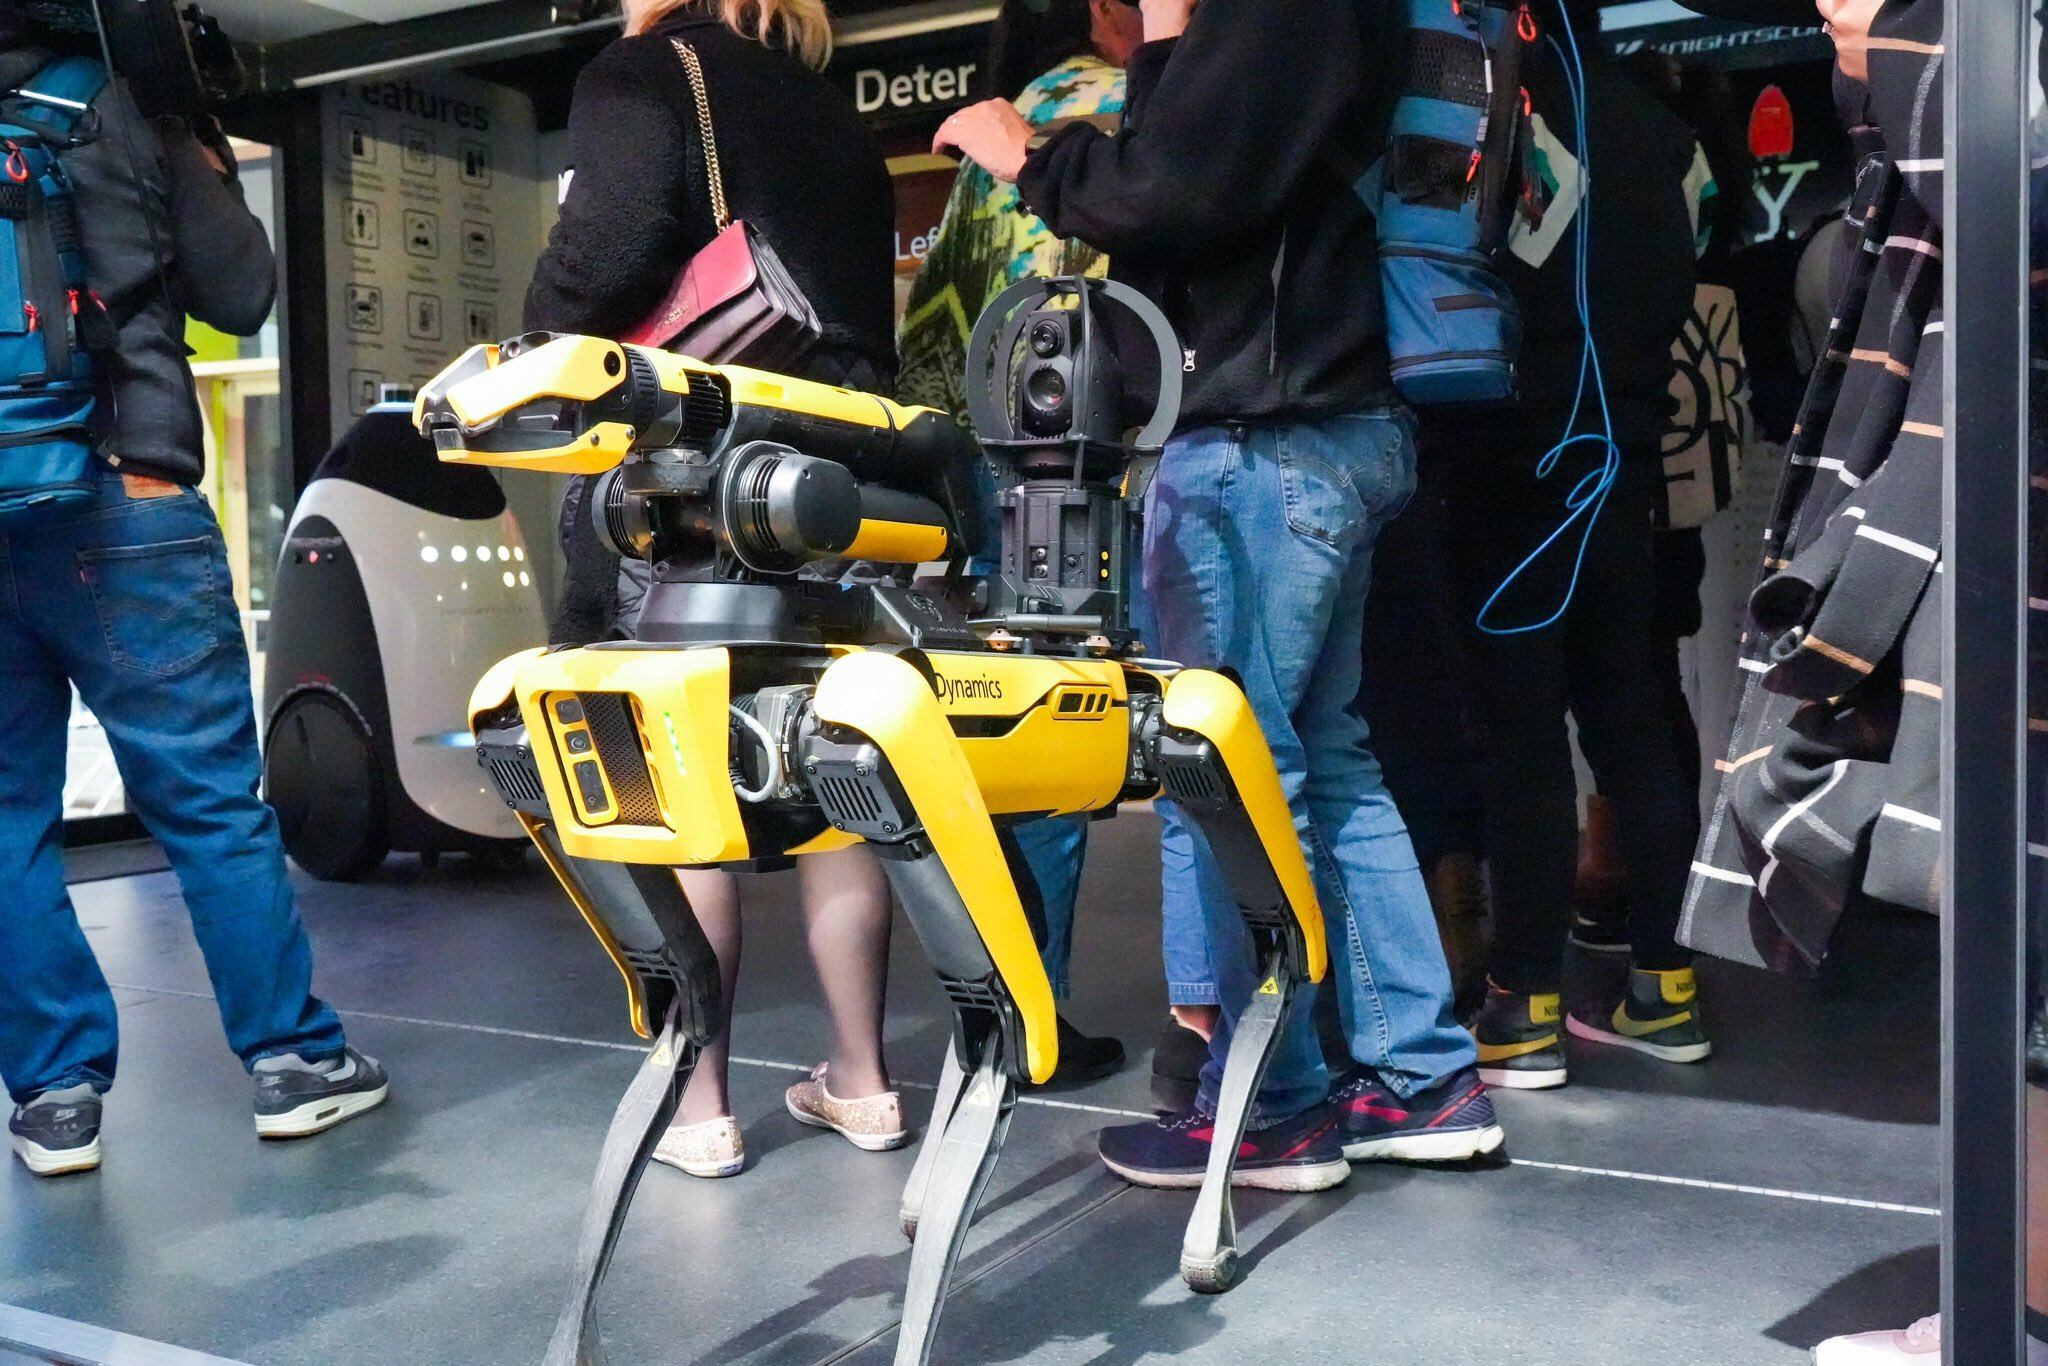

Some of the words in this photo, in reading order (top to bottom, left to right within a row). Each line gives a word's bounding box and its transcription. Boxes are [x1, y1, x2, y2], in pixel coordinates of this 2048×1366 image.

[340, 80, 490, 132] eatures
[854, 62, 977, 113] Deter
[894, 226, 940, 261] Lef
[934, 672, 1003, 706] Dynamics
